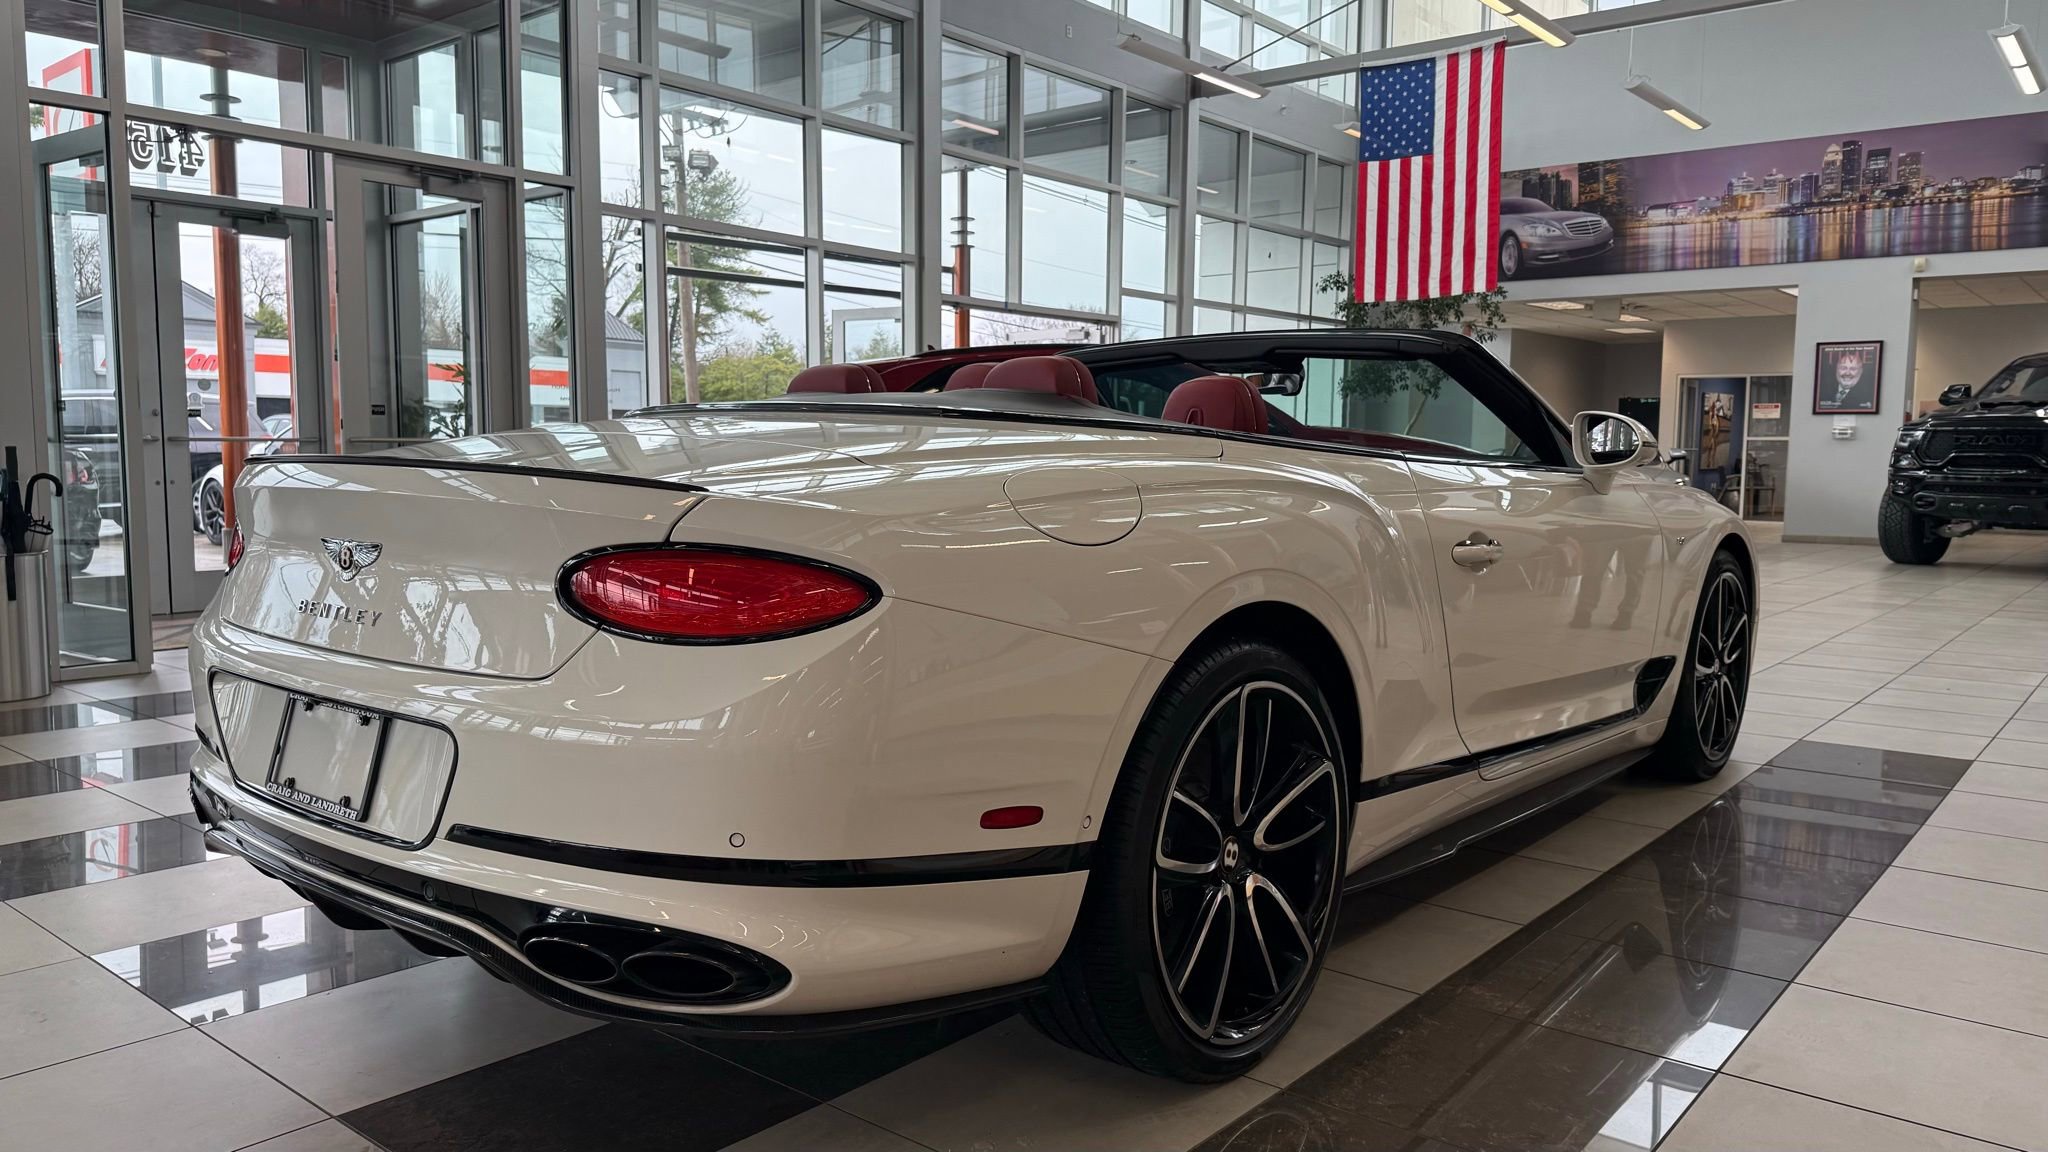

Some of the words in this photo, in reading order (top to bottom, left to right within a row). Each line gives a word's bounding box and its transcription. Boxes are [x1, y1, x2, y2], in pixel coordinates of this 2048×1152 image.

[297, 599, 383, 628] BENTLEY
[266, 781, 292, 798] CRAIG
[291, 790, 311, 804] AND
[309, 797, 358, 821] LANDRETH
